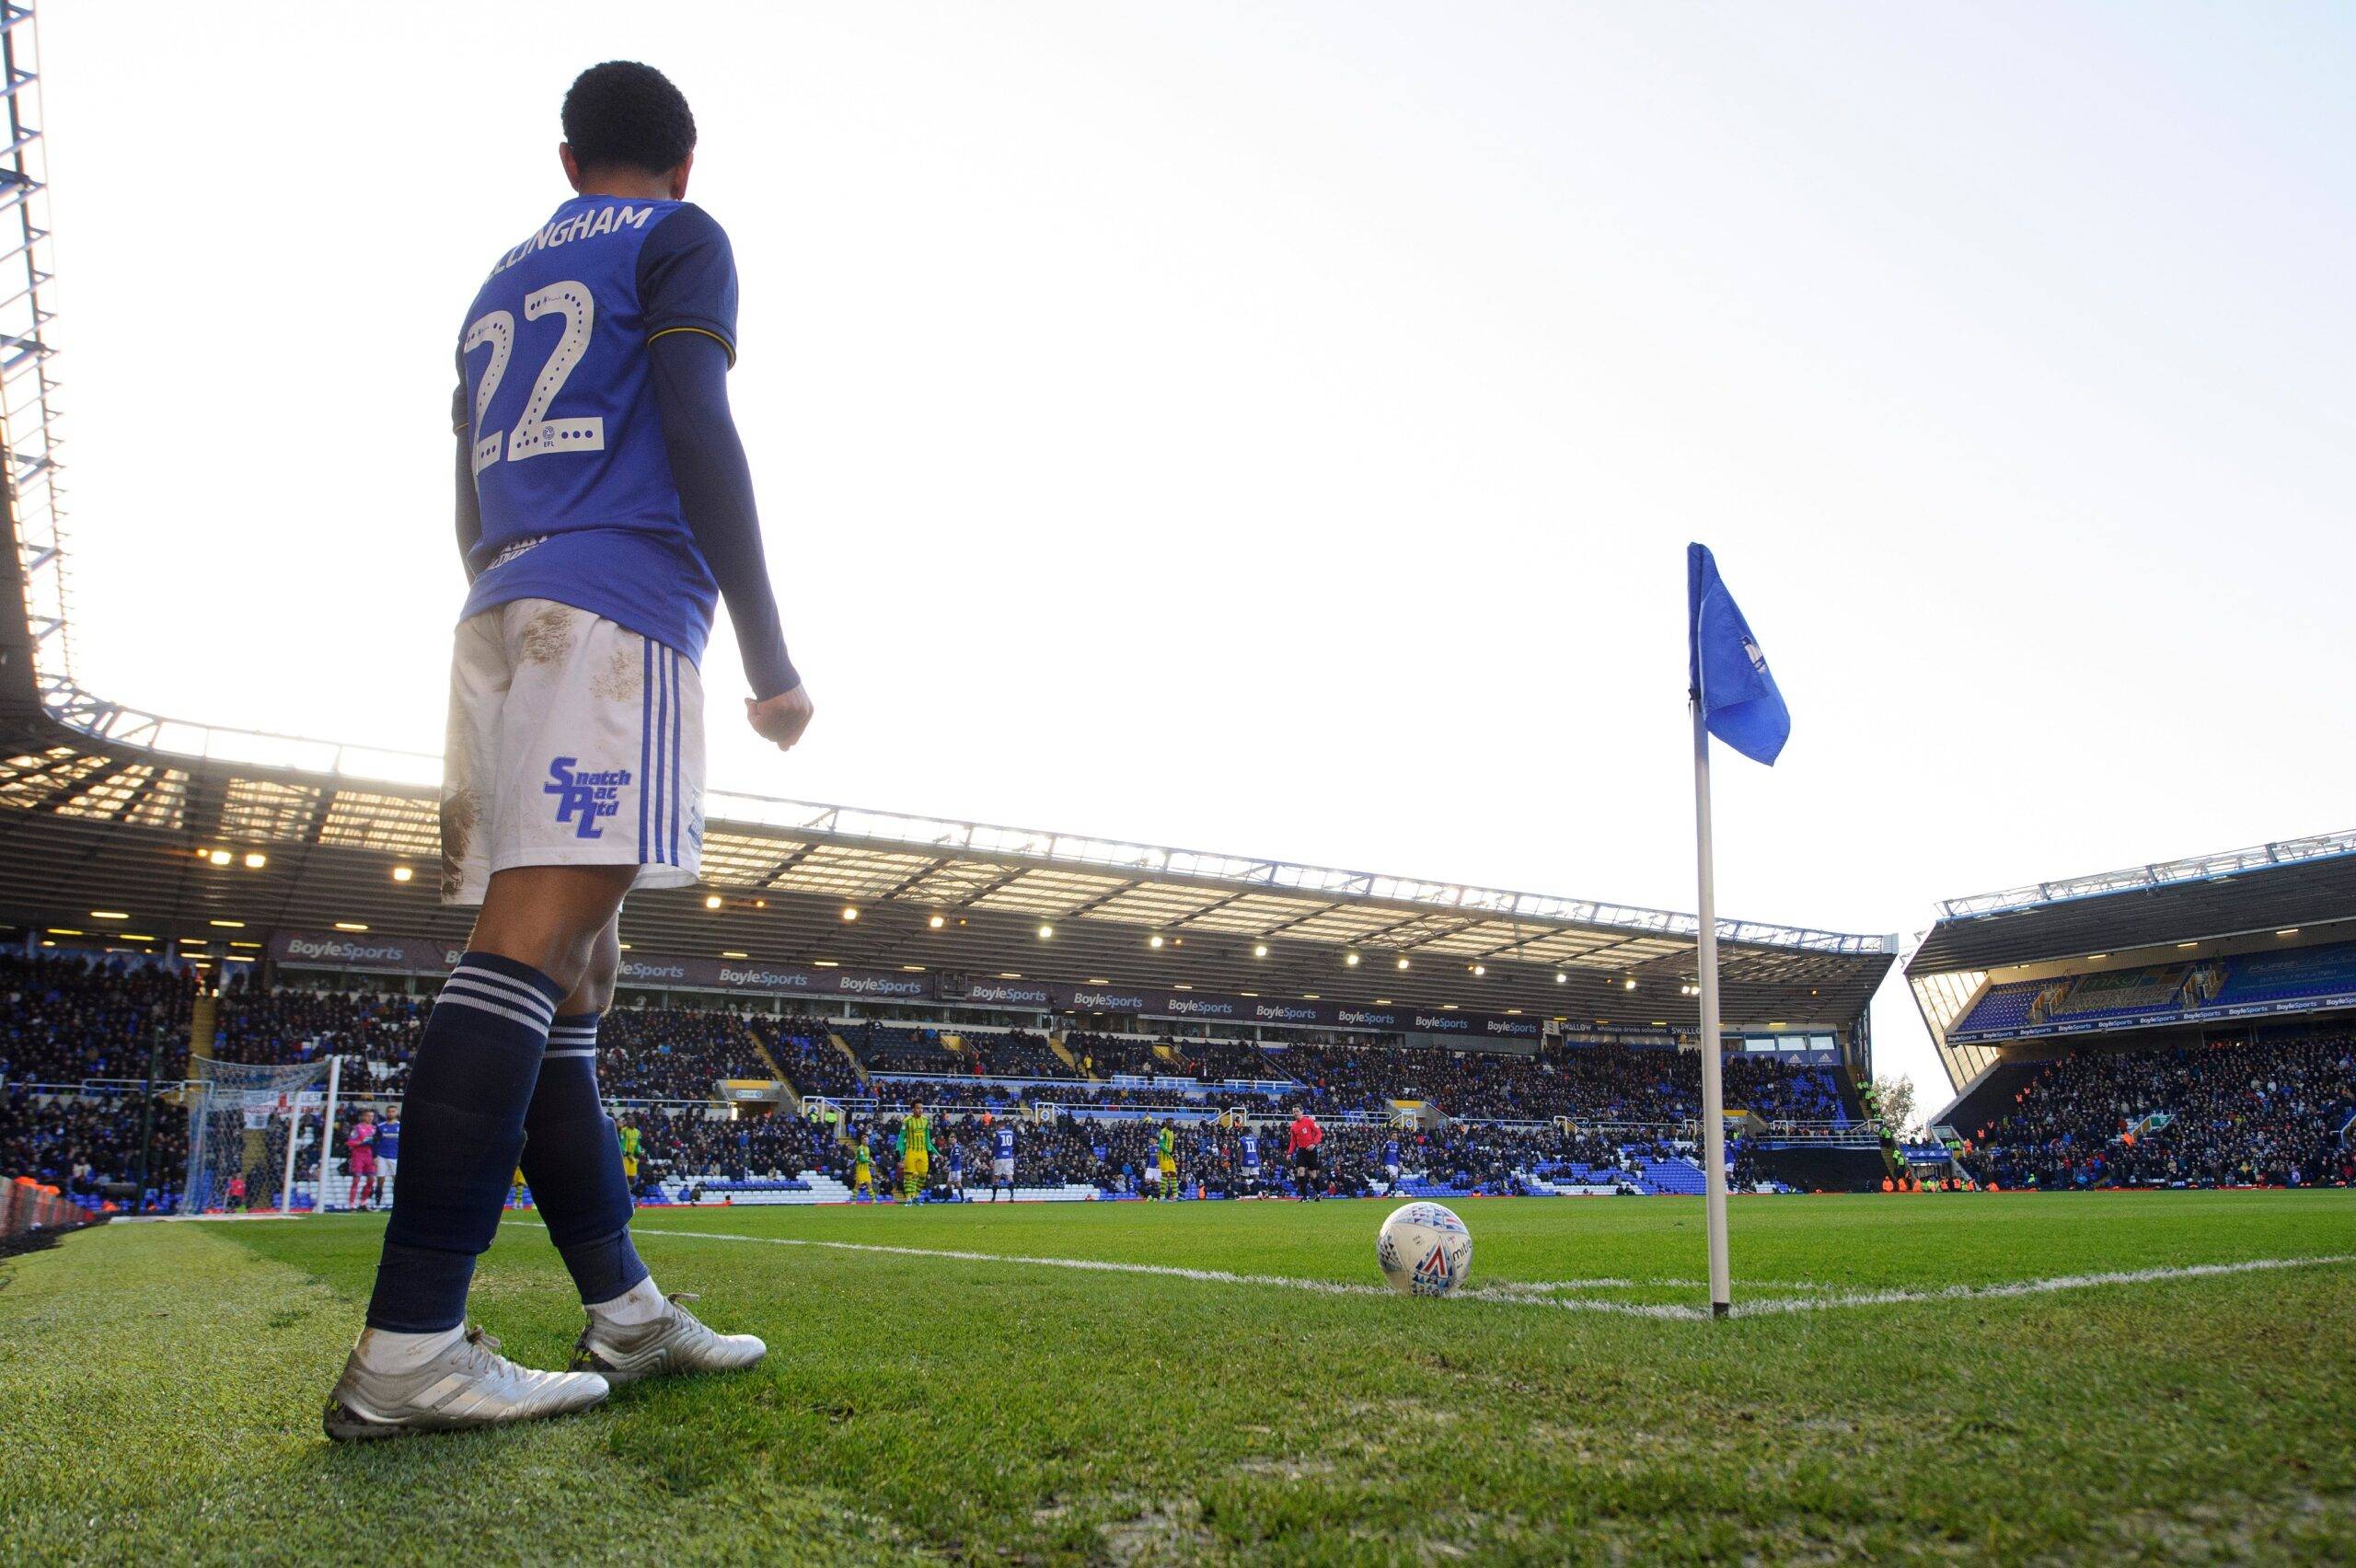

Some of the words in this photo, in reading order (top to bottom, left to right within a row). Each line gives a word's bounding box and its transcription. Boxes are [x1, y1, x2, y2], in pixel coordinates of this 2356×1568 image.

[491, 205, 654, 276] LLINGHAM
[462, 280, 606, 476] 22
[543, 756, 632, 795] Snatch
[288, 940, 405, 961] BoyleSports
[618, 960, 685, 979] leSports
[719, 968, 808, 987] BoyleSports
[839, 975, 922, 994] BoyleSports
[972, 986, 1047, 1003] BoyleSports
[1073, 992, 1143, 1009] BoyleSports
[1168, 998, 1233, 1014] BoyleSports
[1256, 1005, 1317, 1020] BoyleSports
[2228, 1005, 2269, 1016] BoyleSports
[2276, 1000, 2317, 1011] BoyleSports
[1338, 1010, 1395, 1025] BoyleSports
[2140, 1014, 2177, 1024] BoyleSports
[2183, 1010, 2221, 1020] BoyleSports
[1415, 1016, 1468, 1031] BoyleSports
[1487, 1020, 1537, 1034] BoyleSports
[1560, 1022, 1592, 1032] SWALLOW
[1670, 1027, 1701, 1035] SWALLO
[2020, 1026, 2052, 1035] BoyleSports
[2058, 1022, 2092, 1032] BoyleSports
[2098, 1019, 2133, 1028] BoyleSports
[1000, 1135, 1013, 1147] 10
[1245, 1141, 1257, 1153] 11
